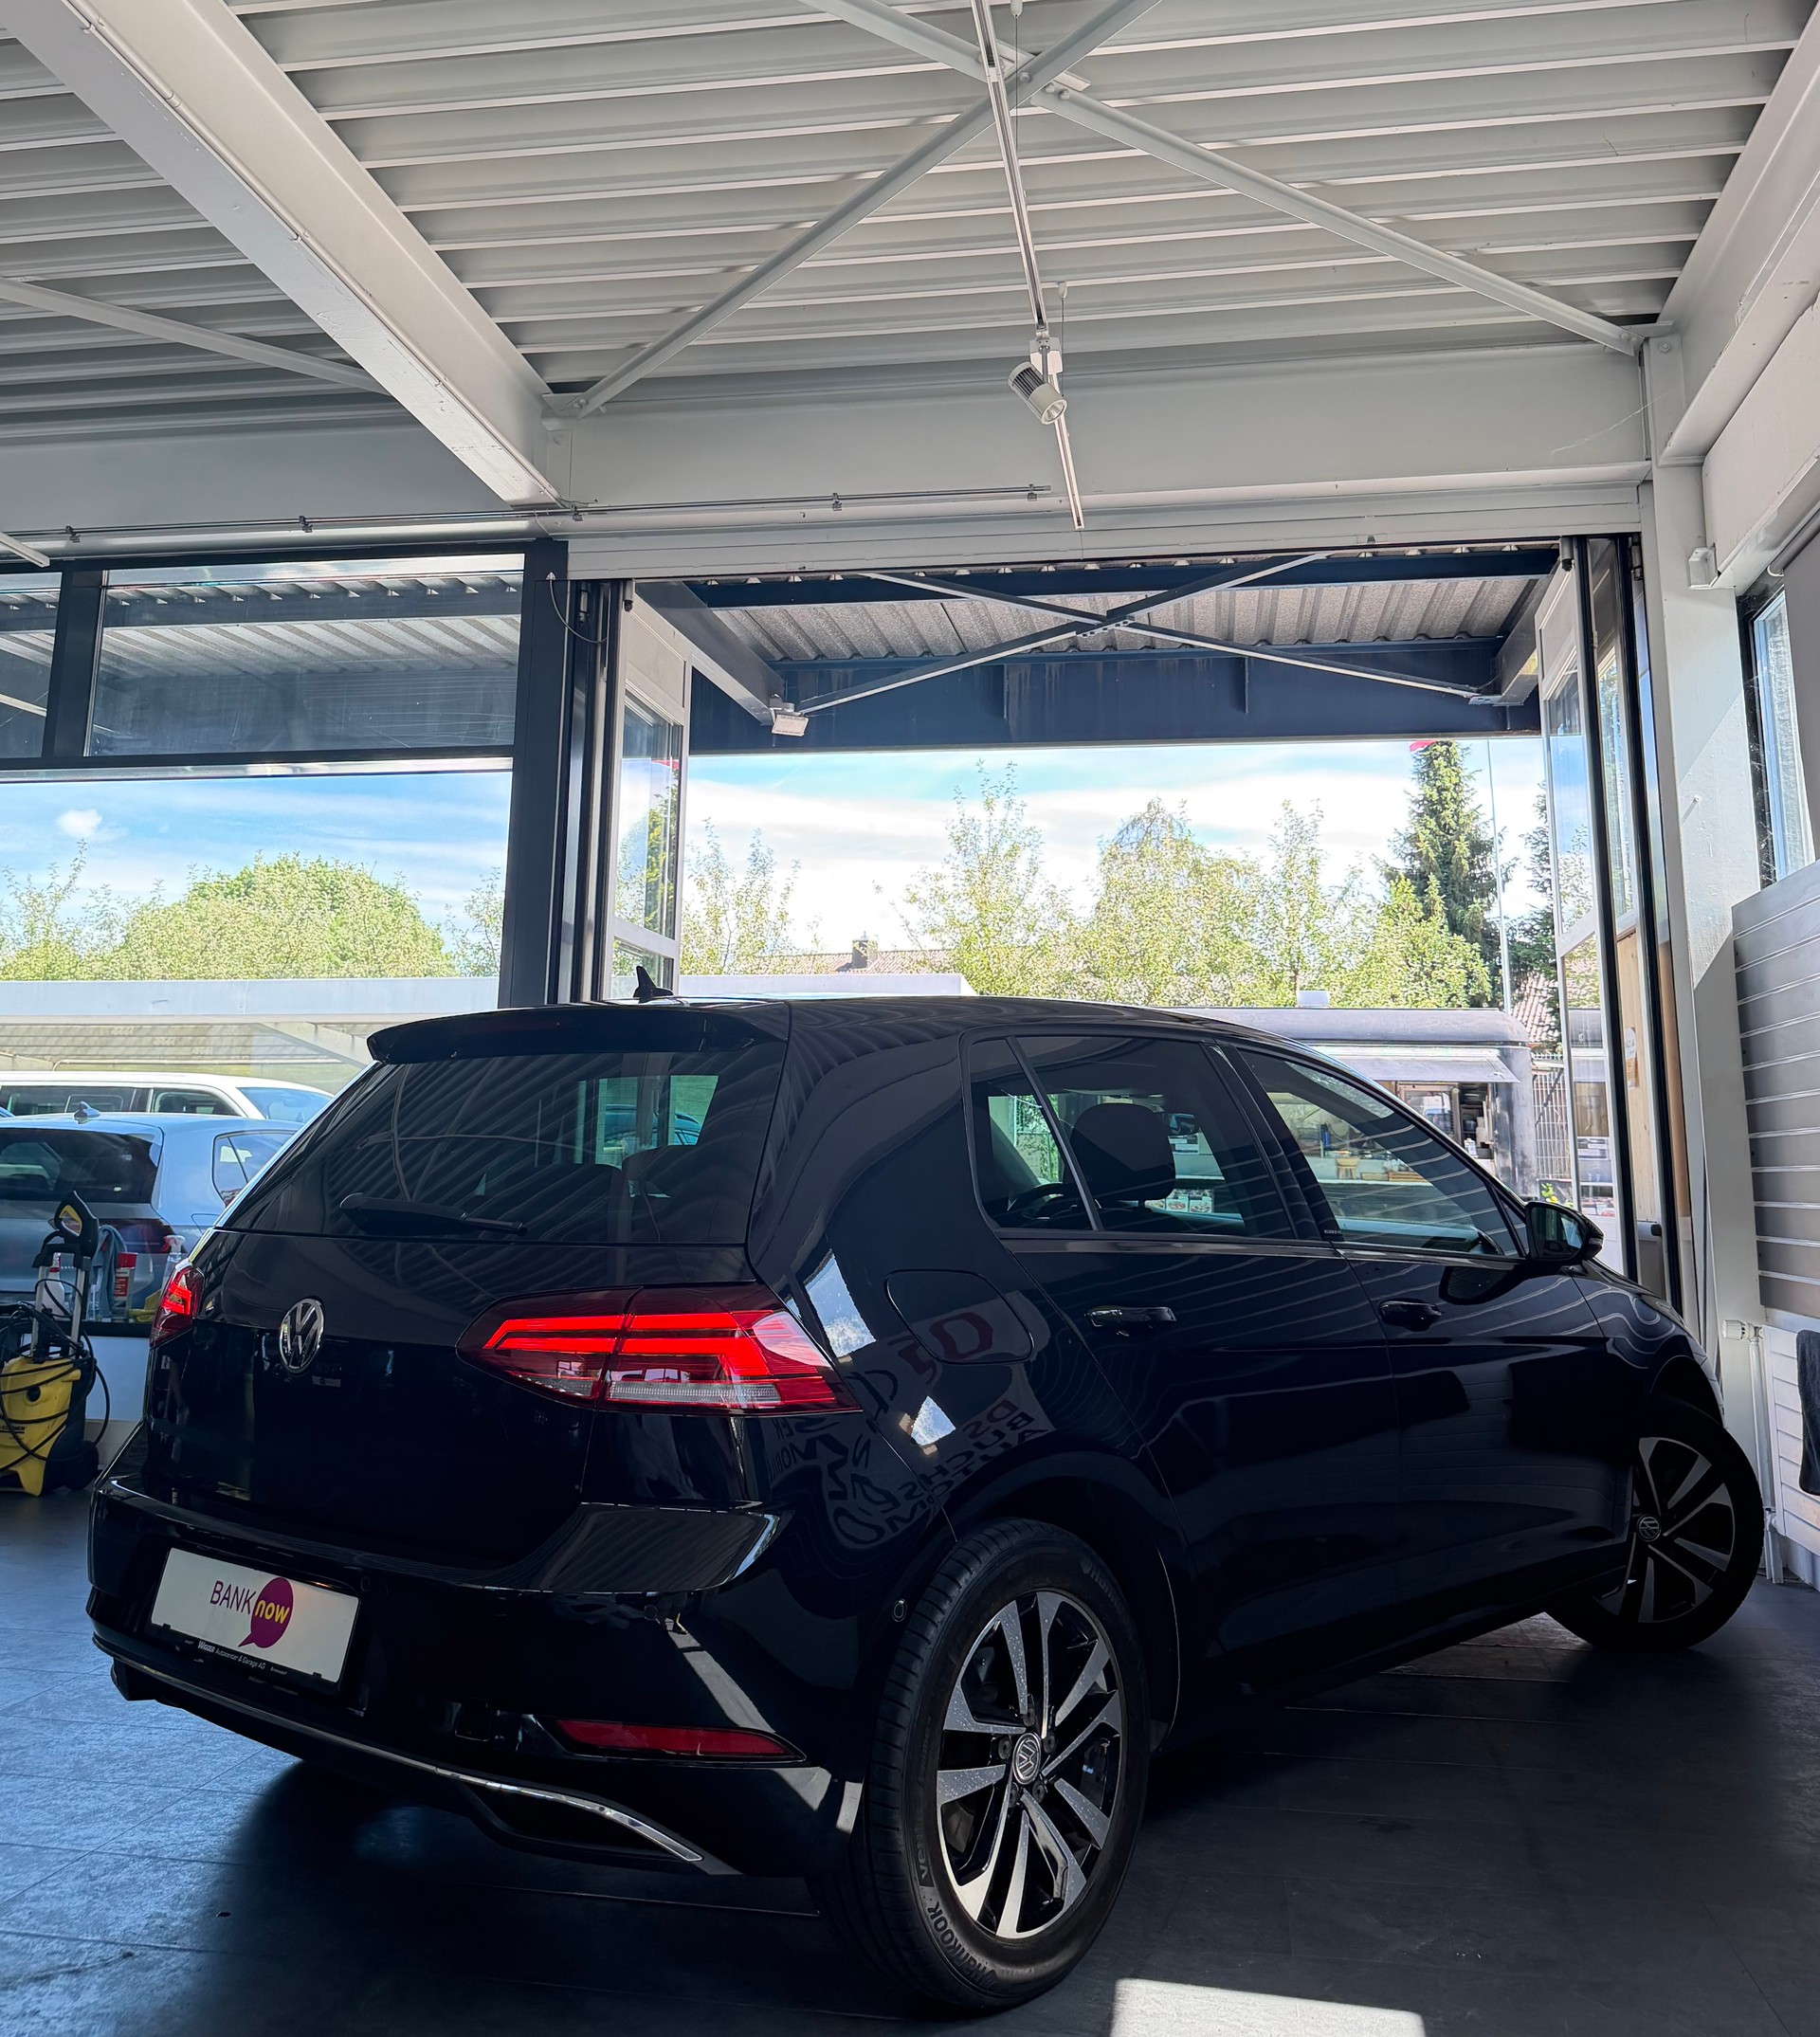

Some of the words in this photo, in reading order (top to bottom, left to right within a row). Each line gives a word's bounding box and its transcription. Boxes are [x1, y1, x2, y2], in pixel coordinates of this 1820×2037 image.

[209, 1580, 257, 1614] BANK
[255, 1599, 290, 1624] now
[242, 1656, 259, 1668] Garage
[257, 1662, 266, 1670] AG
